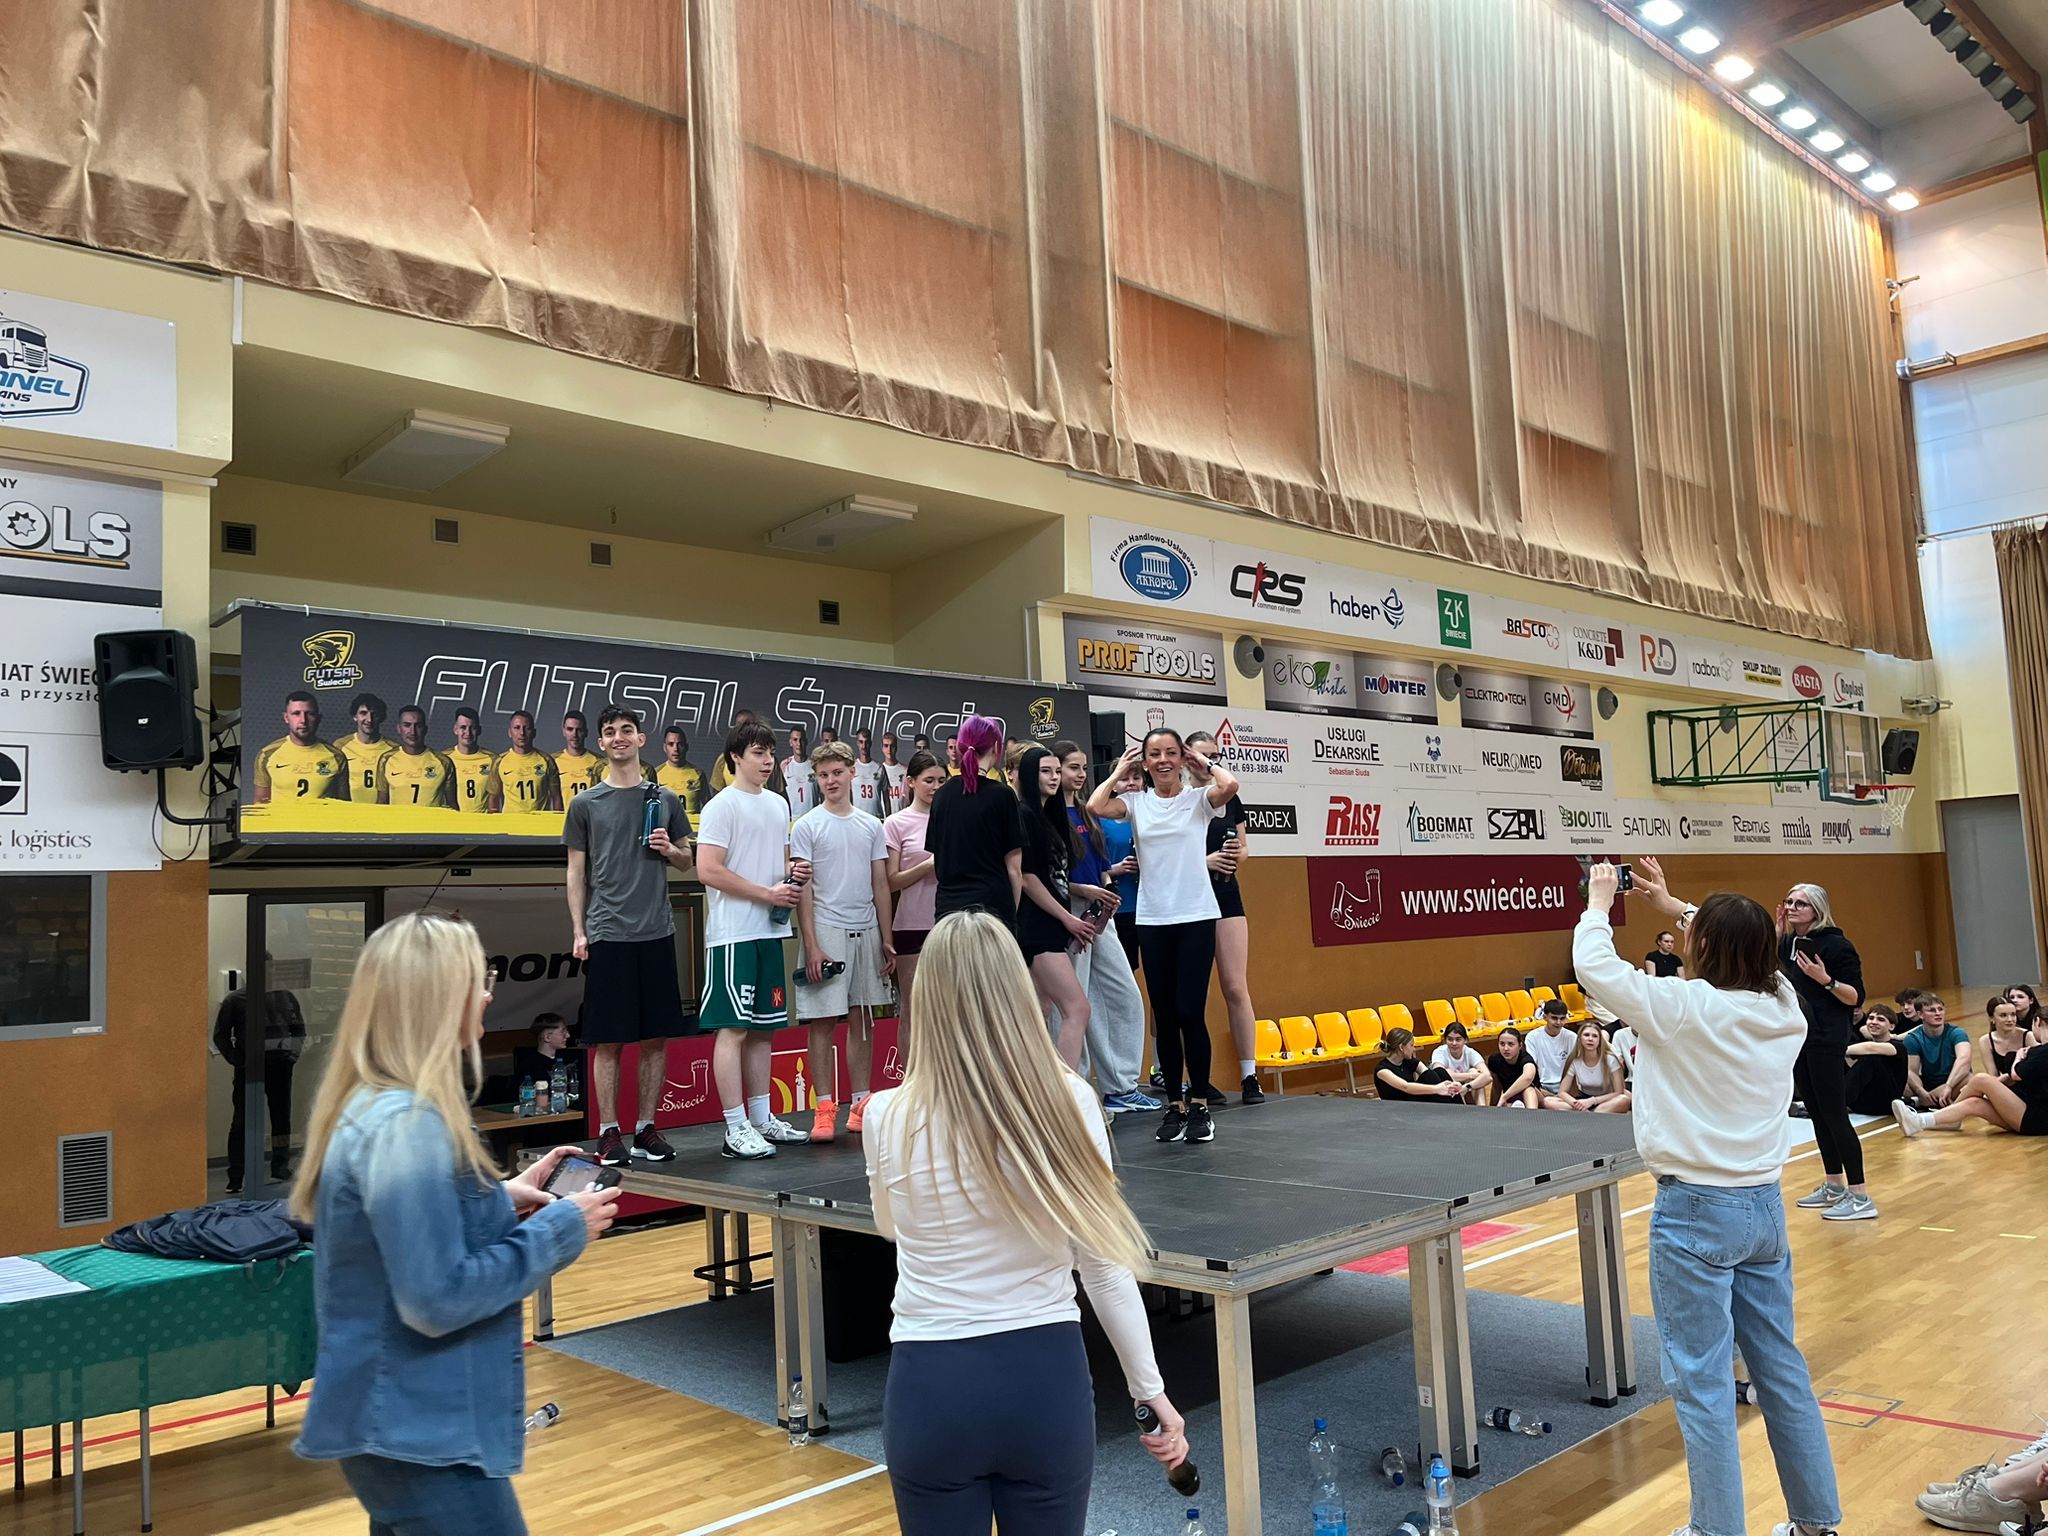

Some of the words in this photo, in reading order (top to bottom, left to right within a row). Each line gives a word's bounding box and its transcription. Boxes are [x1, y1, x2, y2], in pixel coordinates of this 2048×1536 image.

[1110, 540, 1128, 563] Firma
[1128, 533, 1198, 576] Handlowo-Usługowa
[1136, 574, 1178, 590] AKROPOL
[1230, 563, 1306, 607] CRS
[1257, 602, 1277, 611] common
[1285, 606, 1301, 615] system
[1330, 591, 1381, 620] haber
[1506, 618, 1546, 638] BASCO
[1573, 626, 1608, 643] CONCRETE
[1146, 633, 1177, 643] TYTULARNY
[1077, 638, 1216, 680] PROFTOOLS
[1578, 641, 1603, 660] K&D
[307, 667, 360, 680] FUTSAL
[1273, 654, 1317, 689] eko
[1742, 660, 1759, 672] SKUP
[1365, 673, 1427, 697] MONTER
[1794, 673, 1821, 691] BASTA
[414, 655, 738, 736] FUTSAL
[1234, 724, 1253, 733] USŁUGI
[1328, 727, 1365, 741] USŁUGI
[1315, 740, 1380, 761] DEKARSKIE
[1228, 763, 1240, 772] Tel.
[1242, 764, 1283, 774] 693-388-604
[1329, 767, 1354, 775] Sebastian
[1409, 762, 1463, 774] INTERTWINE
[297, 779, 308, 797] 2
[364, 770, 374, 789] 6
[411, 784, 420, 804] 7
[466, 780, 476, 799] 8
[517, 780, 534, 800] 11
[798, 787, 804, 802] 1
[861, 784, 873, 799] 33
[1326, 796, 1381, 836] RASZ
[1417, 816, 1473, 832] BOGMAT
[1566, 811, 1612, 828] BIOUTIL
[1623, 816, 1671, 837] SATURN
[1401, 877, 1565, 915] www.swiecie.eu
[1344, 905, 1381, 930] Świecie
[486, 952, 586, 982] on
[662, 1091, 706, 1112] Świecie
